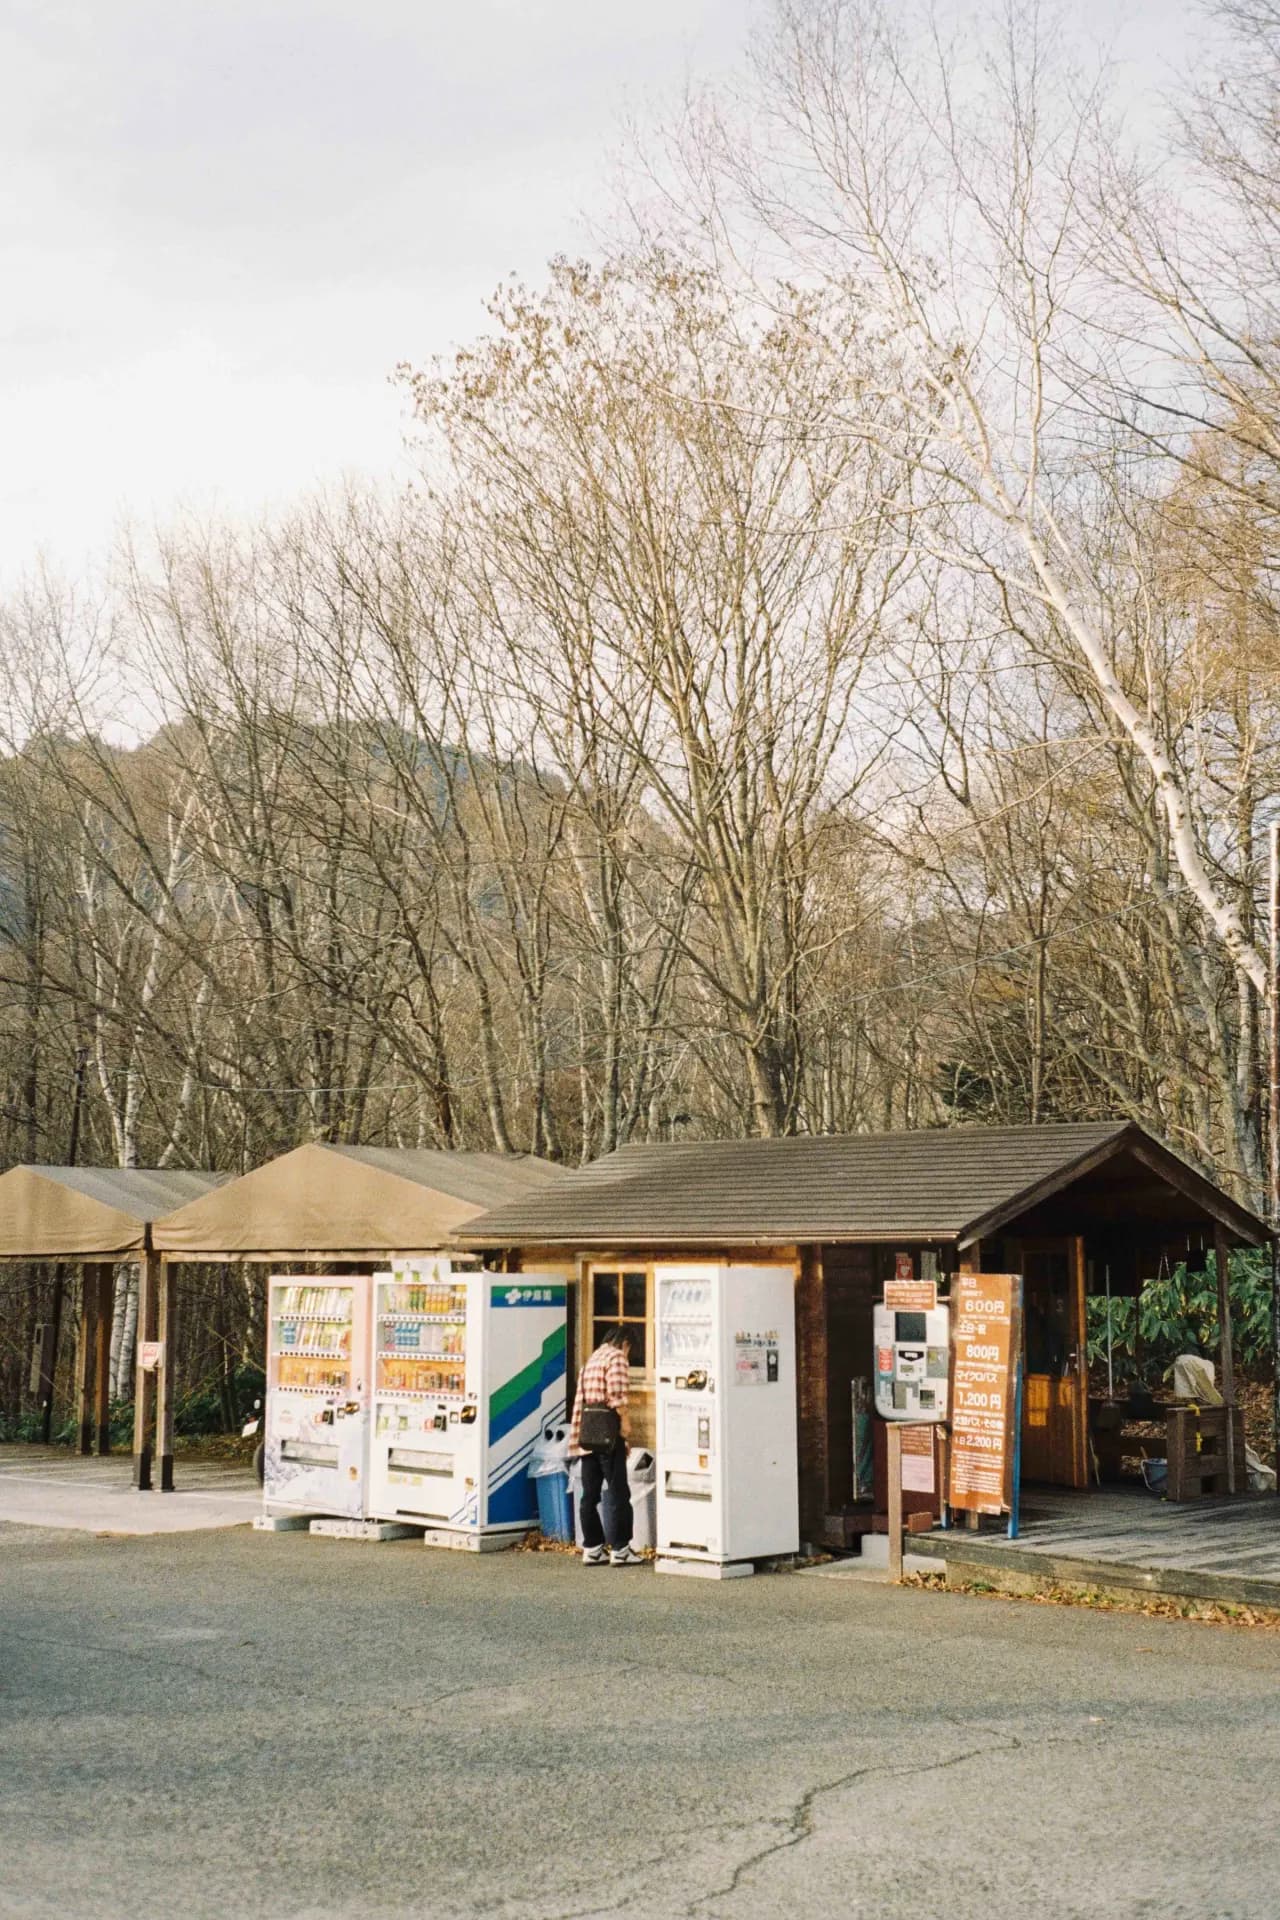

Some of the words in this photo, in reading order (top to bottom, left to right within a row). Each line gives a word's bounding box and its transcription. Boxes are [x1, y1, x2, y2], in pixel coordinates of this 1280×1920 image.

[965, 1300, 1004, 1314] 600円
[967, 1344, 999, 1361] 800円
[956, 1370, 997, 1383] マイクロバス
